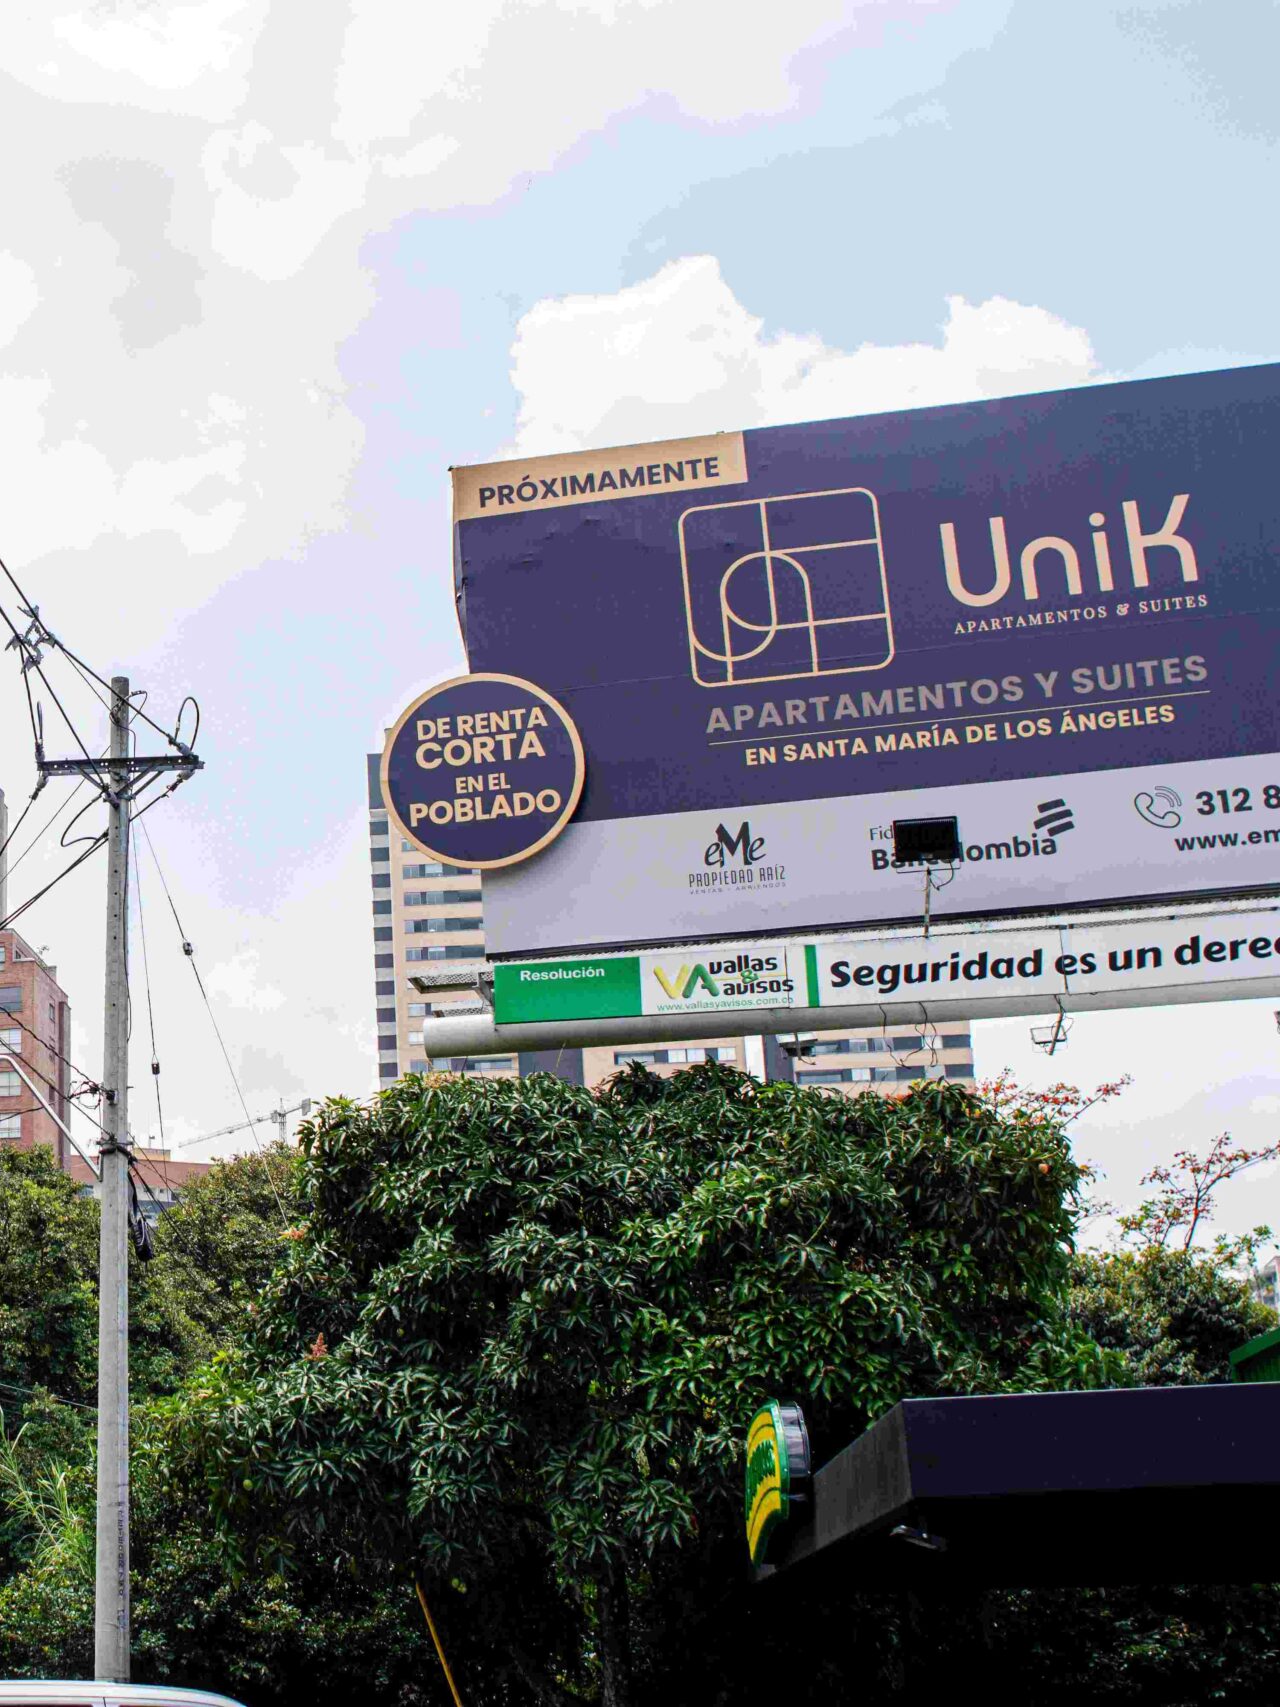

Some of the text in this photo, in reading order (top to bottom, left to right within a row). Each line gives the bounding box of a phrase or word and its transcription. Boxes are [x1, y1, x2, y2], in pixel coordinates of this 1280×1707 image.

[479, 457, 720, 508] PRÓXIMAMENTE
[954, 594, 1209, 635] APARTAMENTOS & SUITES
[705, 655, 1208, 734] APARTAMENTOS Y SUITES
[416, 706, 549, 741] DE RENTA
[745, 705, 1176, 766] EN SANTA MARÍA DE LOS ÁNGELES
[415, 730, 546, 769] CORTA
[455, 772, 511, 794] EN EL
[1195, 787, 1253, 816] 312
[409, 788, 561, 828] POBLADO
[689, 869, 754, 888] PROPIEDAD
[520, 966, 606, 982] Resolución
[723, 978, 794, 996] avisos
[830, 947, 1043, 994] Seguridad
[1054, 952, 1098, 976] es
[1108, 945, 1163, 972] un
[656, 996, 794, 1012] www.vallasyavisos.com.co
